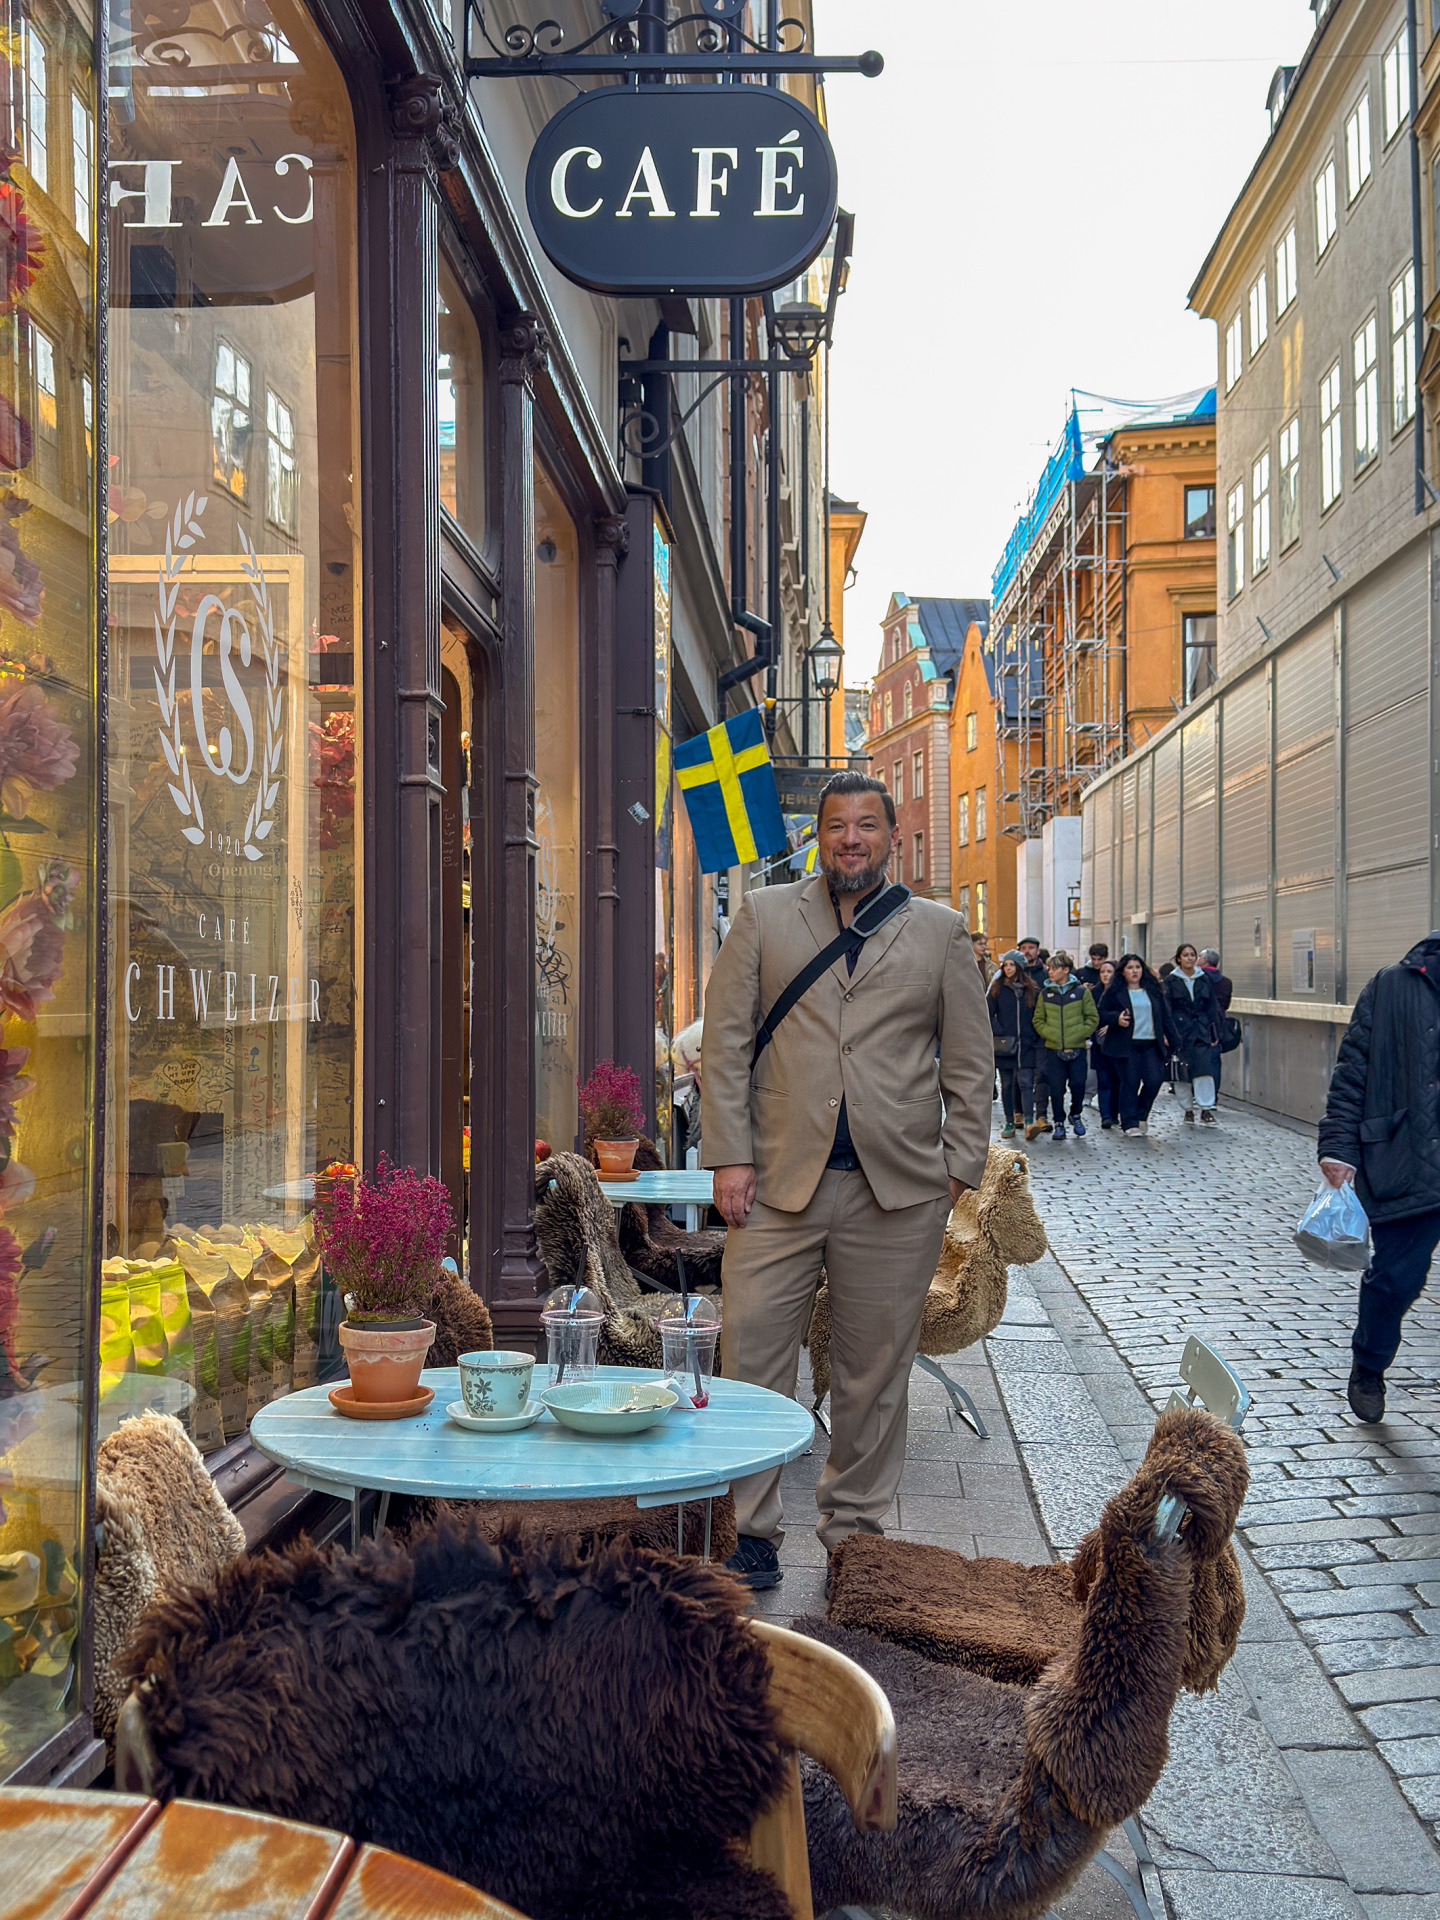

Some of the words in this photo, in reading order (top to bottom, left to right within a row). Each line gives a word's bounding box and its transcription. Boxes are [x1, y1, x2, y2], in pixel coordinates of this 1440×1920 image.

[550, 129, 805, 218] CAFÉ
[209, 831, 240, 857] 1920
[198, 912, 250, 945] CAFÉ
